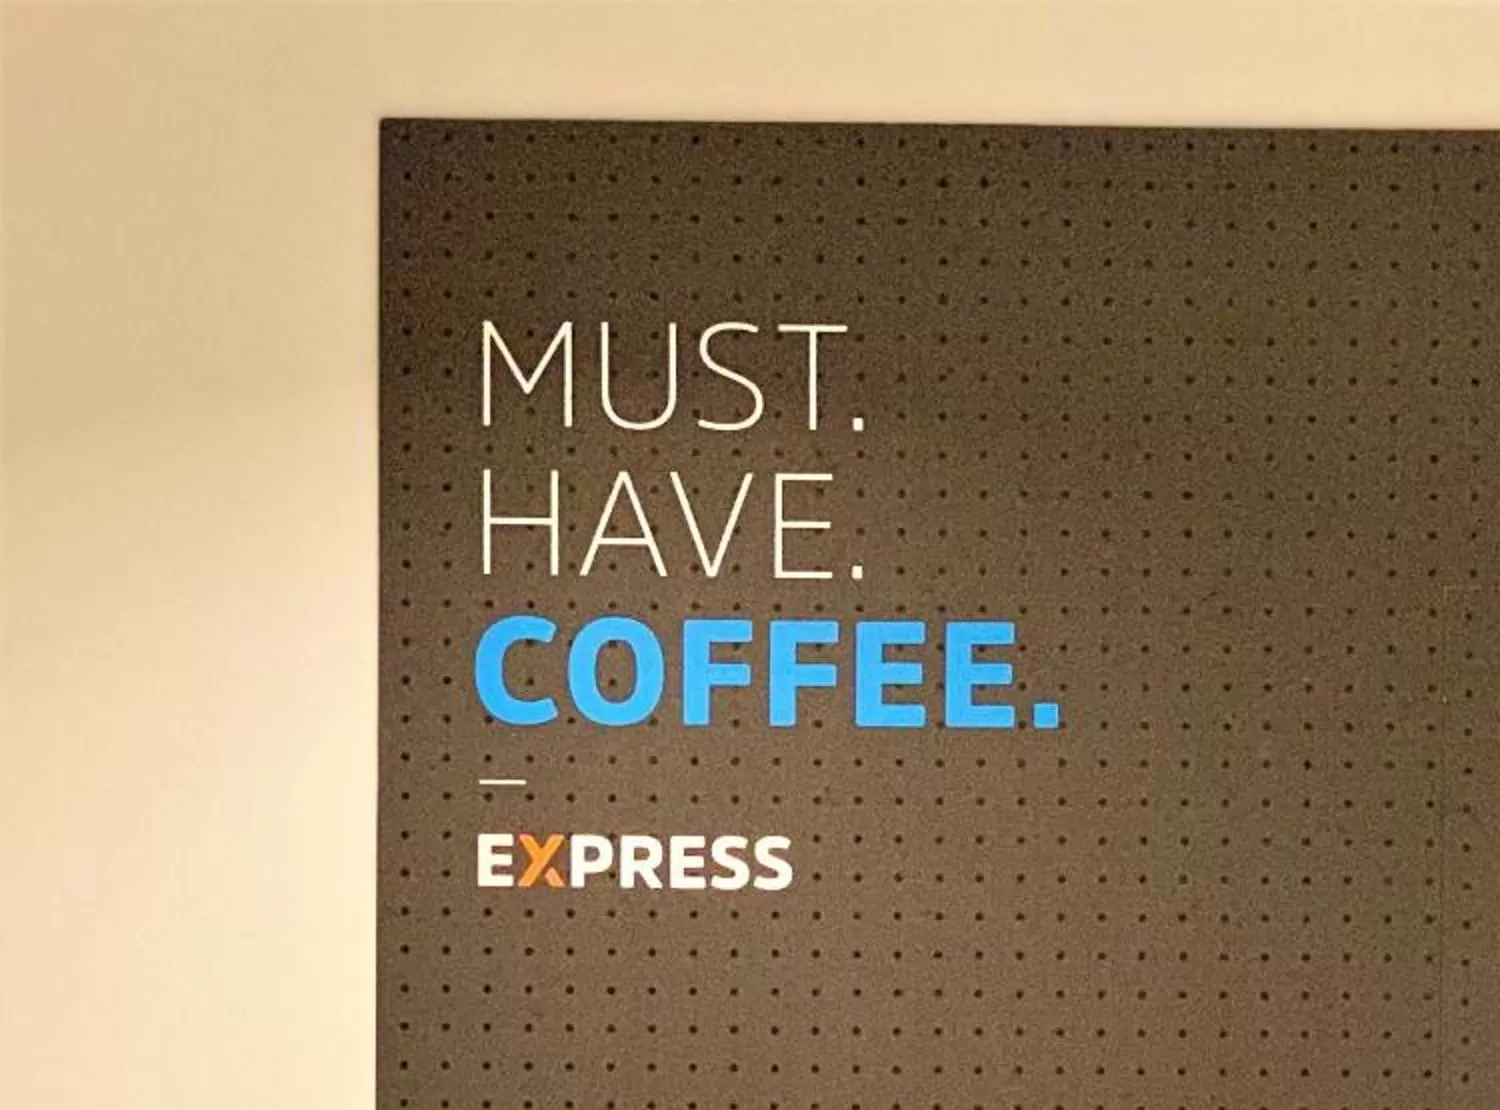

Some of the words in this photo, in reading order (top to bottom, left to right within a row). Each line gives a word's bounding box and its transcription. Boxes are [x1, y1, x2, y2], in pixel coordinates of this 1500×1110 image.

[482, 320, 864, 431] MUST.
[482, 468, 864, 580] HAVE.
[474, 615, 1060, 729] COFFEE.
[477, 834, 793, 890] EXPRESS
